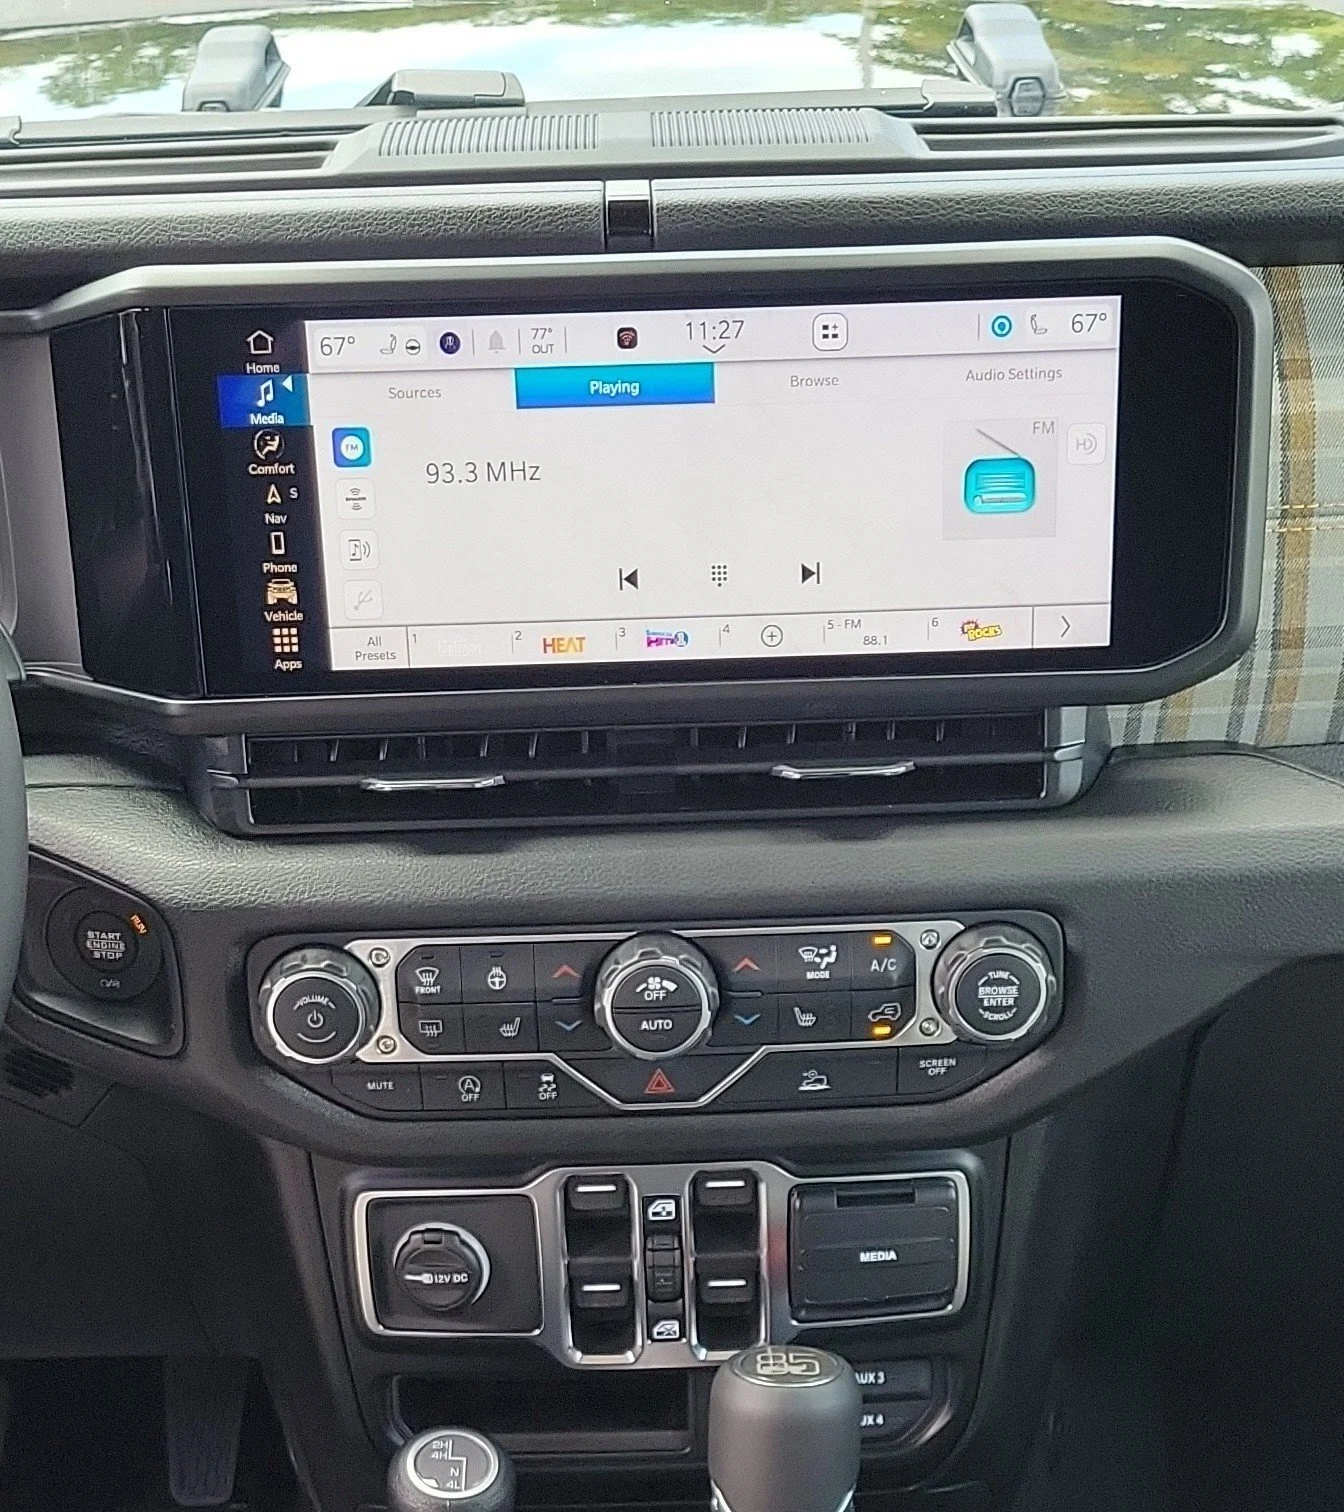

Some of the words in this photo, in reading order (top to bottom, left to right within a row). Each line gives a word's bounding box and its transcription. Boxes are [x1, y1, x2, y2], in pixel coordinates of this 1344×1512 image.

[1071, 313, 1108, 333] 67°
[530, 327, 553, 341] 77°
[686, 320, 745, 342] 11:27
[319, 335, 356, 357] 67°
[531, 343, 554, 355] OUT
[246, 362, 280, 374] Home
[965, 369, 1005, 382] Audio
[1008, 367, 1063, 382] Settings
[790, 374, 839, 388] Browse
[388, 385, 442, 399] Sources
[590, 381, 640, 397] Playing
[249, 412, 285, 425] Media
[1032, 421, 1055, 434] FM
[248, 462, 295, 475] Comfort
[425, 462, 479, 485] 93.3
[486, 460, 542, 483] MHz
[289, 488, 299, 498] S
[265, 513, 287, 524] Nav
[263, 562, 298, 574] Phone
[264, 611, 304, 622] Vehicle
[827, 620, 835, 630] 5
[844, 619, 862, 630] FM
[932, 618, 939, 628] 6
[619, 628, 626, 637] 3
[722, 624, 730, 634] 4
[367, 636, 382, 647] All
[412, 633, 417, 643] 1
[515, 631, 522, 641] 2
[863, 635, 888, 646] 88.1
[543, 637, 586, 654] HEAT
[355, 651, 397, 661] Presets
[274, 659, 302, 672] Apps
[87, 931, 121, 940] START
[93, 951, 123, 960] STOP
[870, 959, 897, 973] A/C
[806, 971, 830, 979] MODE
[988, 971, 1010, 981] TUNE
[415, 985, 441, 994] FRONT
[978, 986, 1019, 996] BROWSE
[297, 994, 330, 1006] VOLUME
[644, 991, 667, 1001] OFF
[983, 998, 1014, 1007] ENTER
[982, 1010, 1014, 1022] SCROLL
[640, 1019, 673, 1031] AUTO
[919, 1058, 956, 1068] SCREEN
[928, 1067, 946, 1076] OFF
[367, 1082, 395, 1090] MUTE
[461, 1093, 480, 1102] OFF
[539, 1092, 558, 1101] OFF
[859, 1250, 898, 1262] MEDIA
[434, 1273, 451, 1283] 12V
[453, 1272, 469, 1283] DC
[756, 1352, 821, 1376] 85
[877, 1371, 885, 1384] 3
[876, 1413, 884, 1426] 4
[432, 1441, 449, 1449] 2H
[431, 1451, 448, 1460] 4H
[450, 1467, 459, 1477] N
[446, 1480, 460, 1489] 4L
